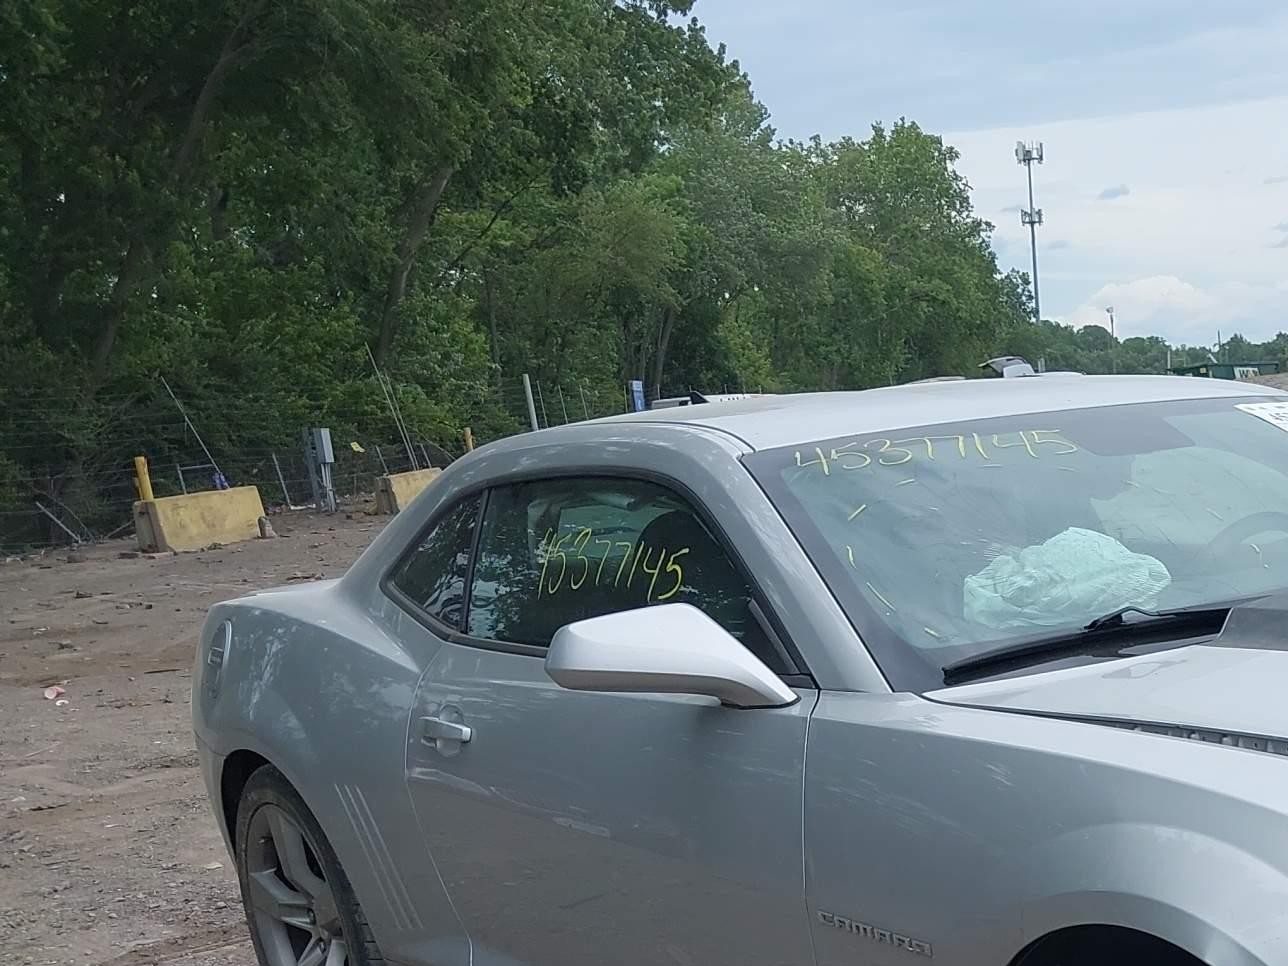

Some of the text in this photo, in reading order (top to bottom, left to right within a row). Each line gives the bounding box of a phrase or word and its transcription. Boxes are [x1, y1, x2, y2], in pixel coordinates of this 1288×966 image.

[794, 429, 1079, 475] 45377145
[537, 528, 689, 603] 45377145
[818, 910, 934, 957] CAMARO
